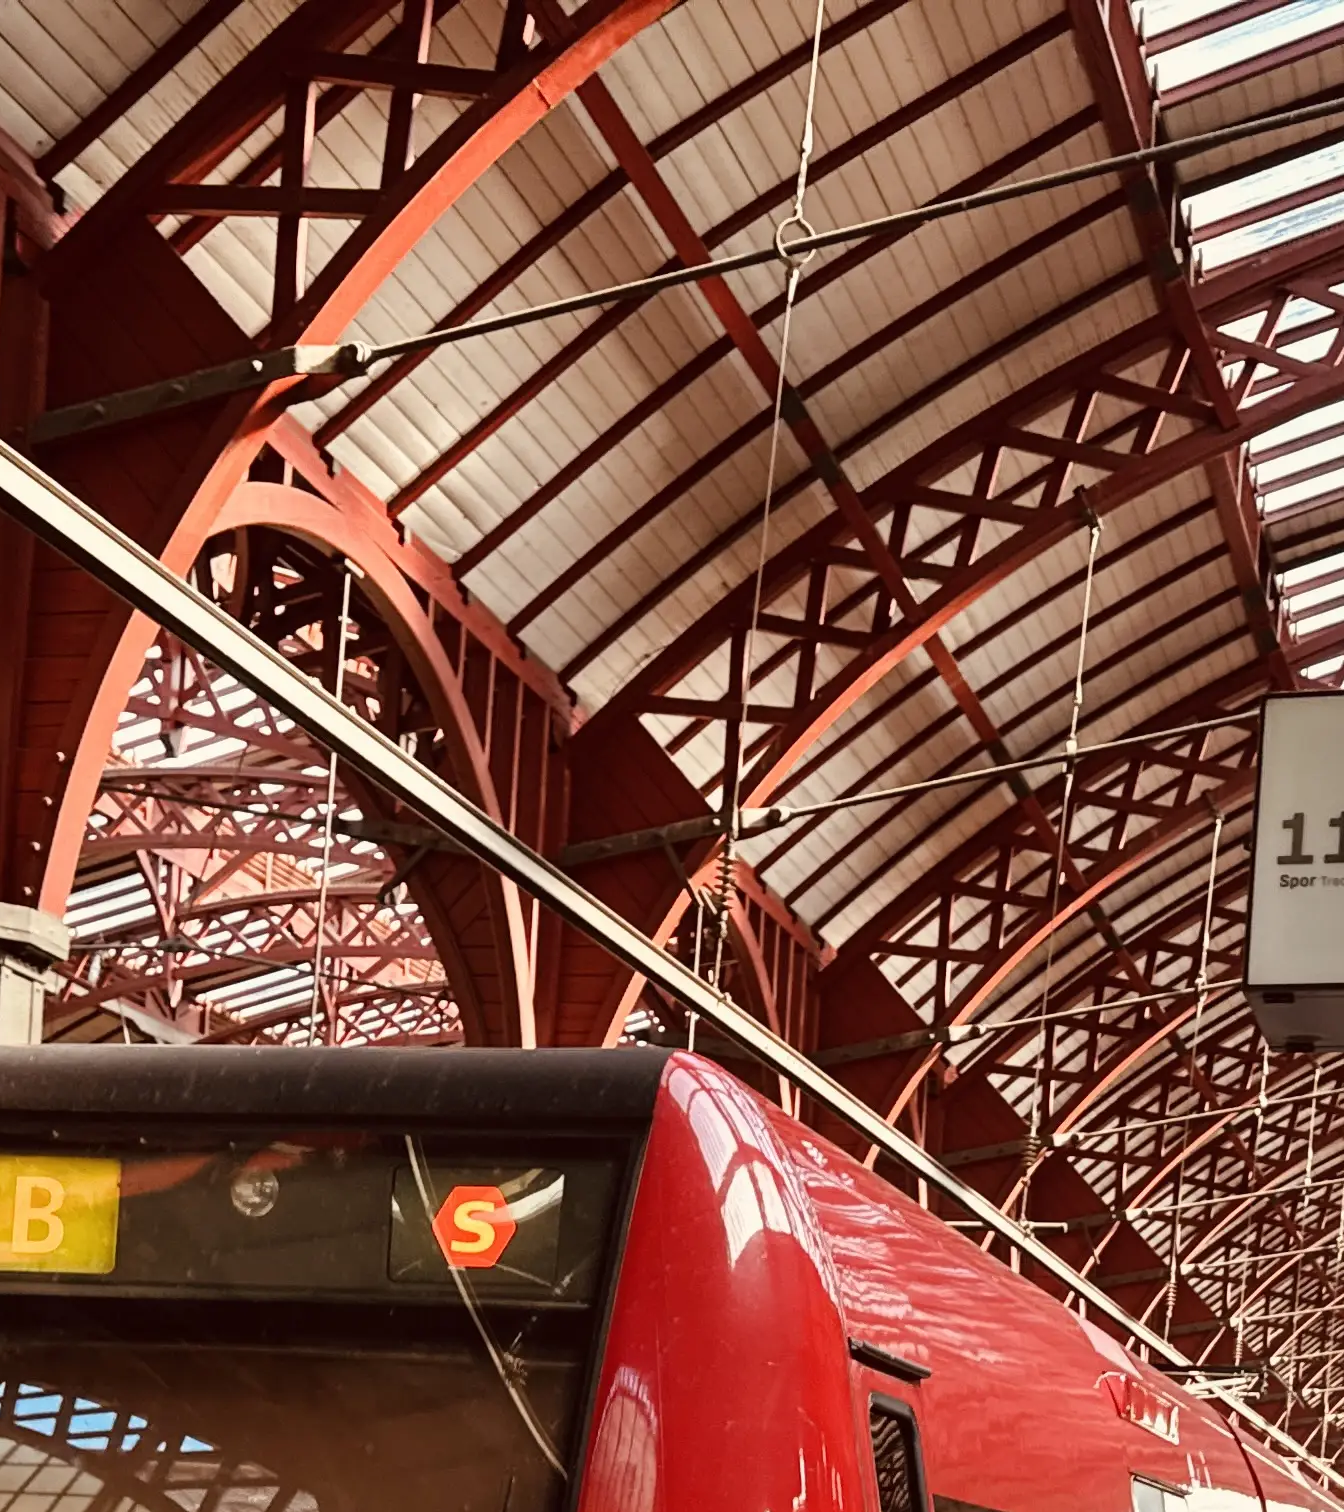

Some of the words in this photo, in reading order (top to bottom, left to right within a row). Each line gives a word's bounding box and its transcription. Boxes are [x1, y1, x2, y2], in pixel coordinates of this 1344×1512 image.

[1280, 874, 1317, 890] Spor
[11, 1176, 65, 1254] B
[451, 1200, 496, 1253] S
